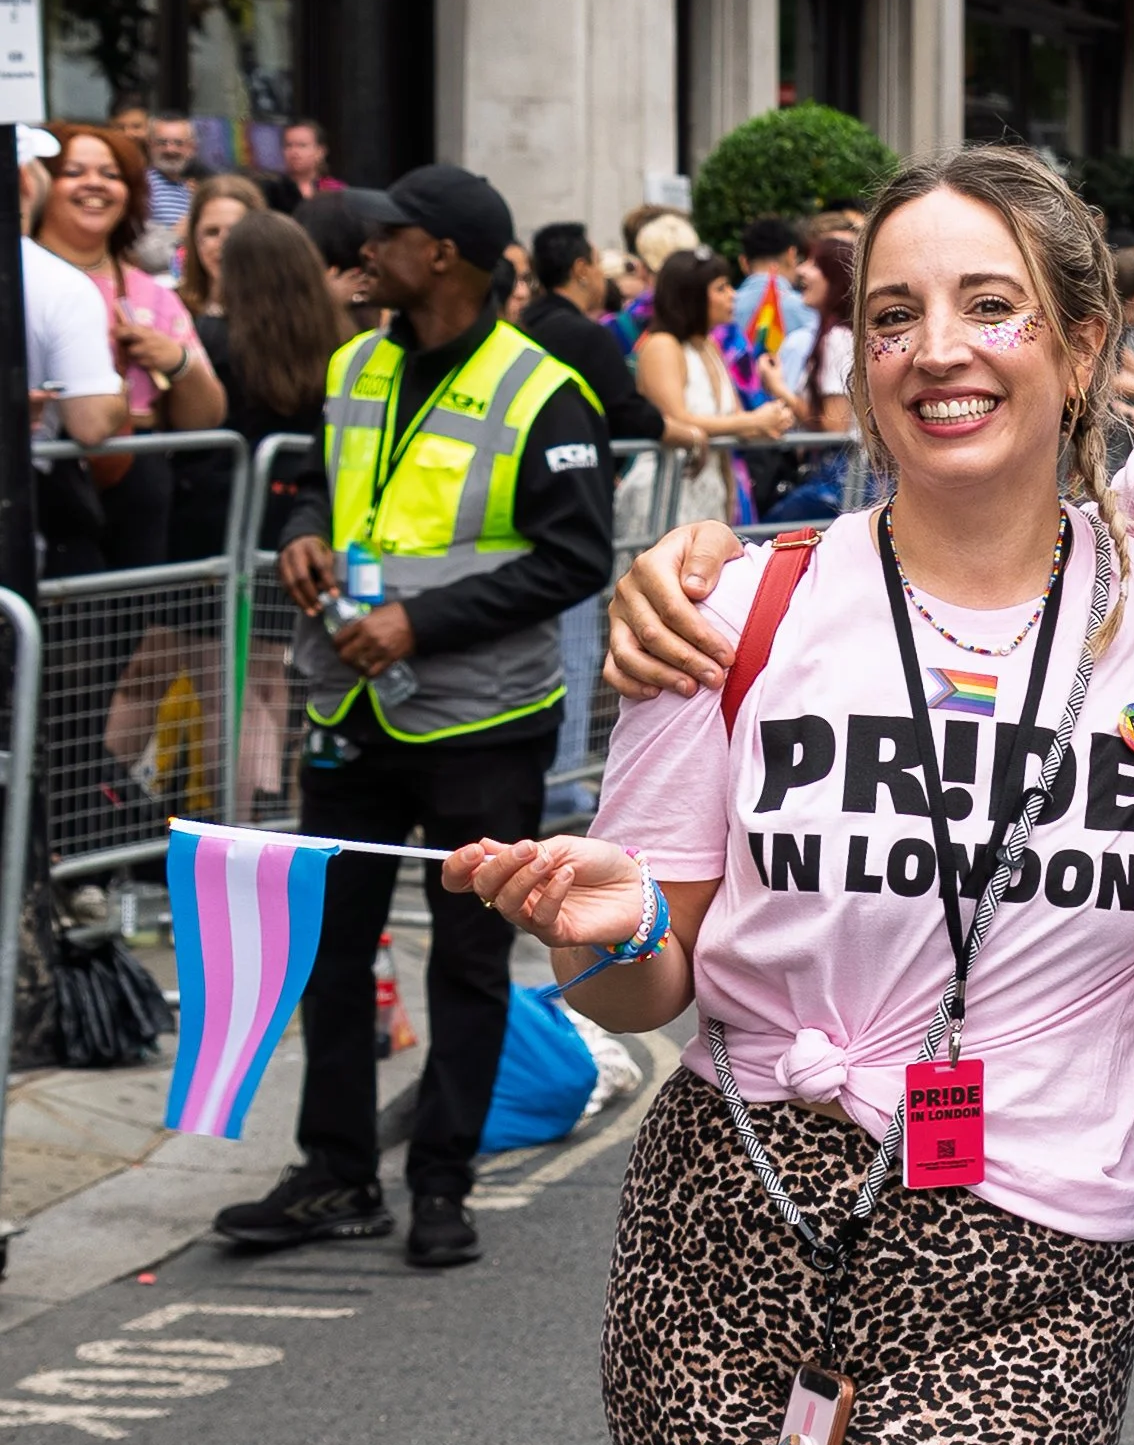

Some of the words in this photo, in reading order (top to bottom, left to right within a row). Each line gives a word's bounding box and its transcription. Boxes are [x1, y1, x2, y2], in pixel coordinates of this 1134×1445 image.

[910, 1085, 980, 1108] PR!DE
[910, 1111, 924, 1122] IN
[928, 1107, 980, 1121] LONDON
